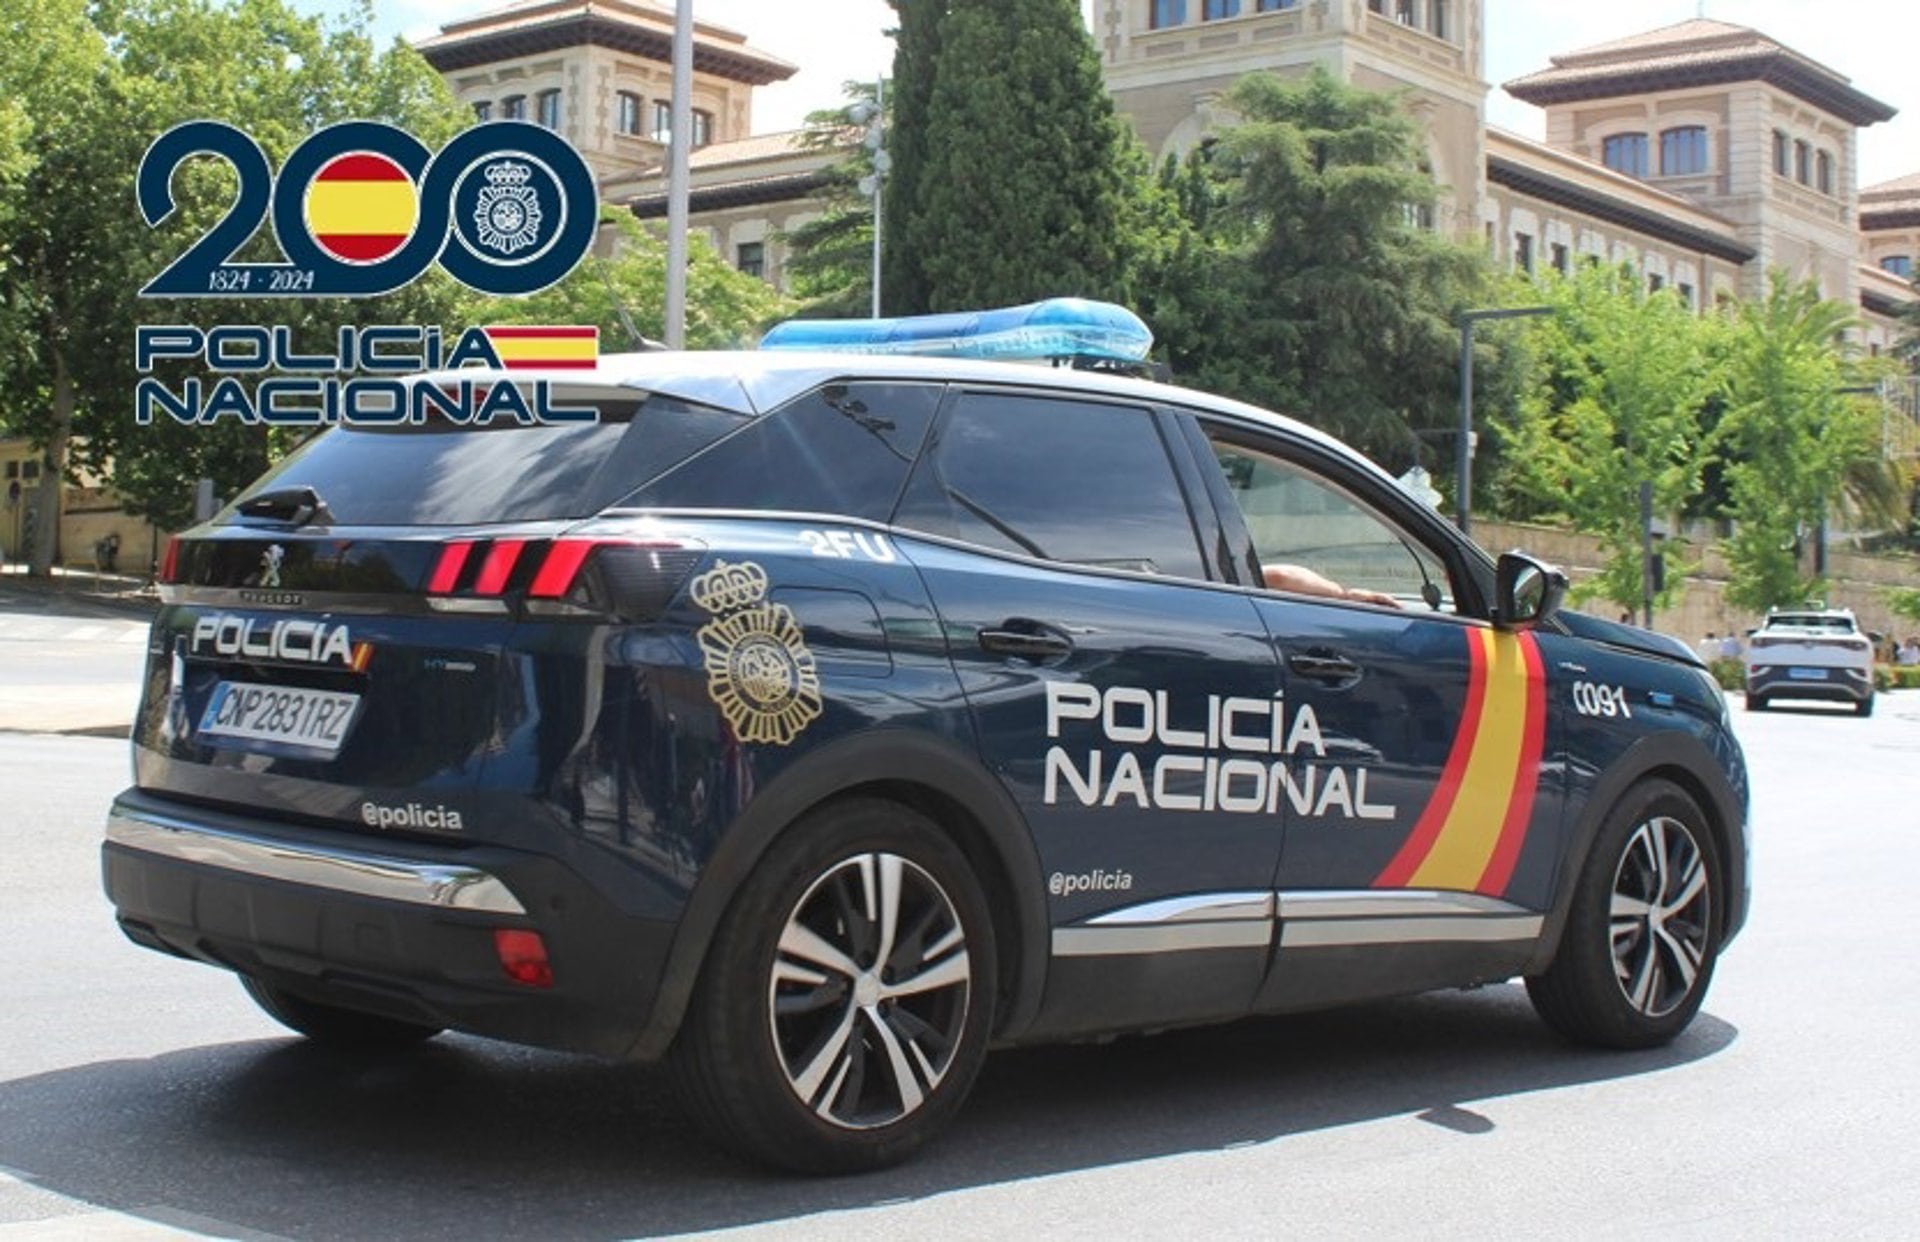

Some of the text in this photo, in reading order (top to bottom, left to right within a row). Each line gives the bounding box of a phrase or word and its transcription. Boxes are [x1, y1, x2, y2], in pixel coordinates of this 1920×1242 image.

[800, 530, 895, 563] 2FU
[1046, 680, 1326, 757] POLICÍA
[1044, 746, 1397, 820] NACIONAL
[362, 802, 462, 829] @policia
[1049, 869, 1132, 896] @policia
